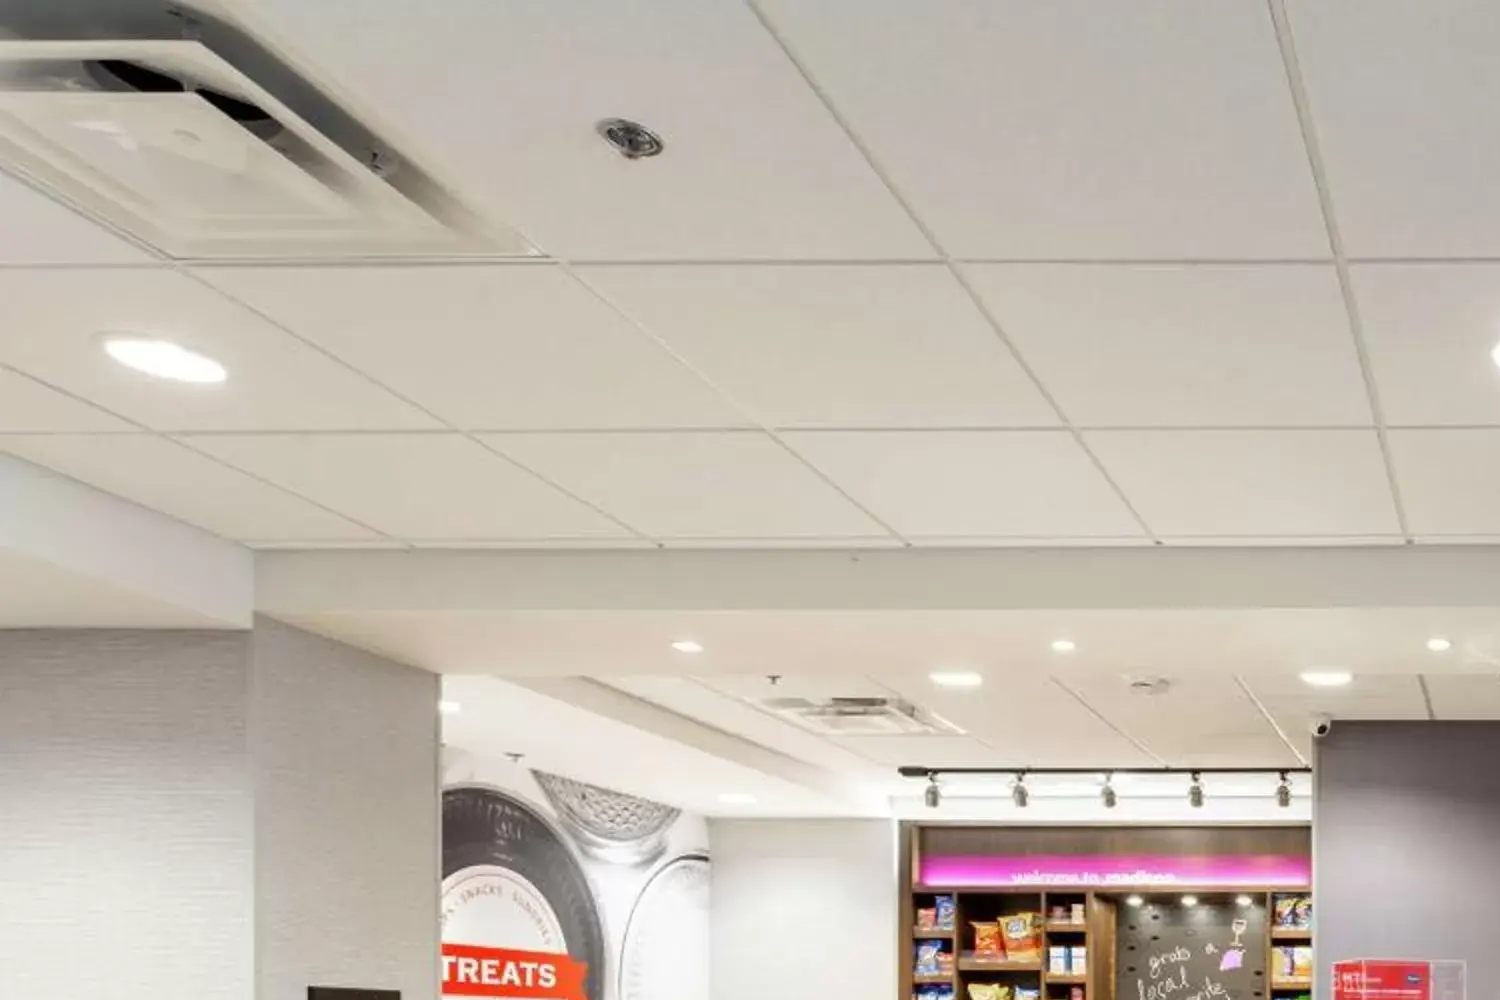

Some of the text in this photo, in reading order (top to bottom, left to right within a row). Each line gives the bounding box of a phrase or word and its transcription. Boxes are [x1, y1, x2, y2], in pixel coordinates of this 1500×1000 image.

[441, 955, 558, 988] TREATS
[1148, 942, 1219, 979] grab a
